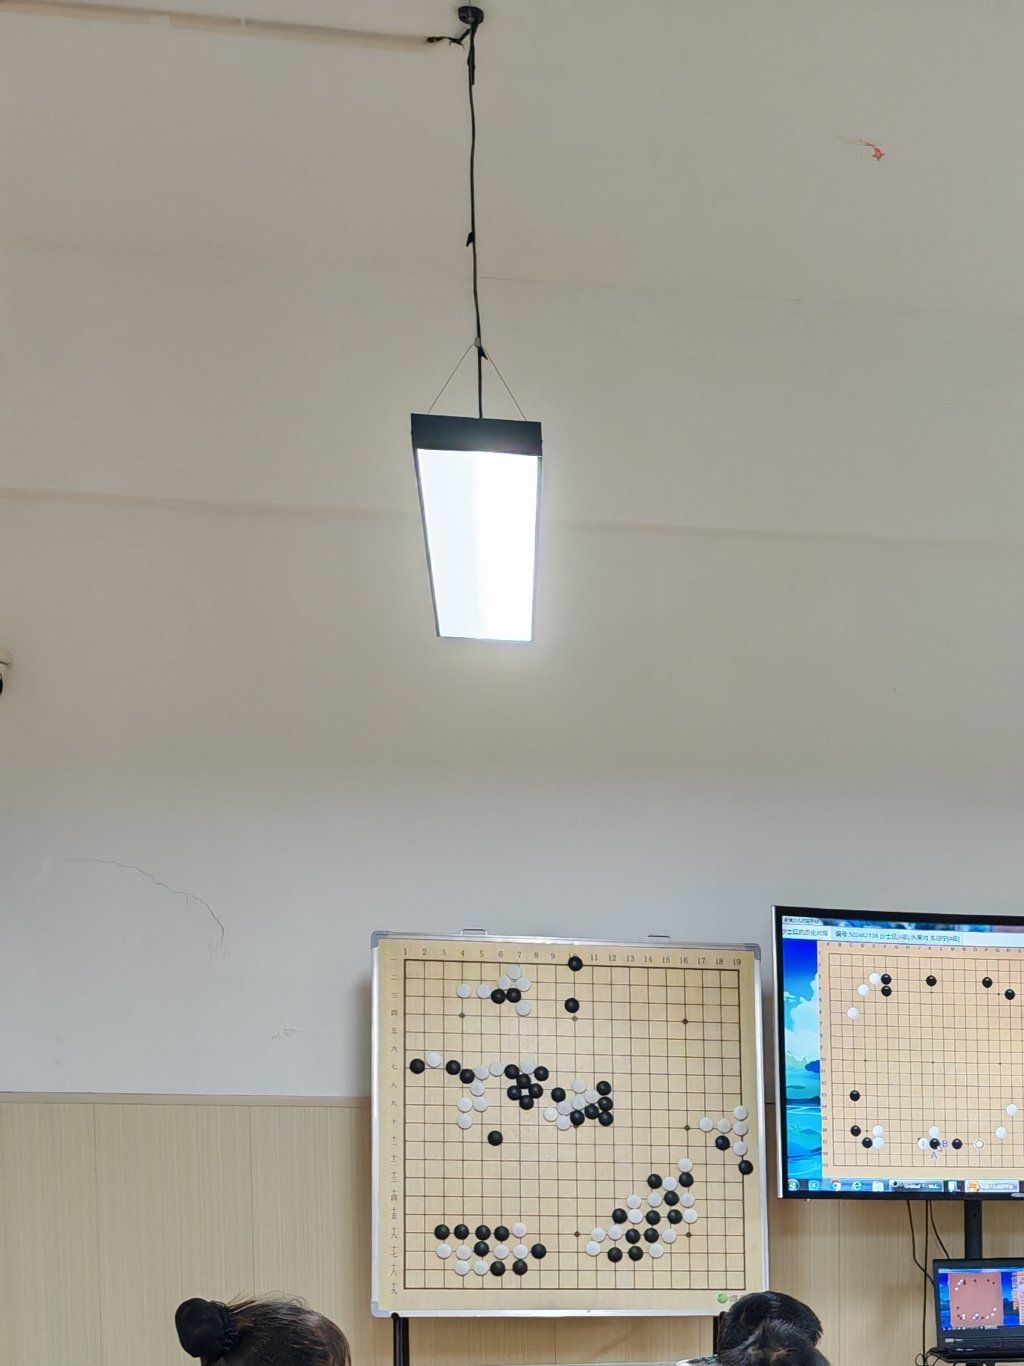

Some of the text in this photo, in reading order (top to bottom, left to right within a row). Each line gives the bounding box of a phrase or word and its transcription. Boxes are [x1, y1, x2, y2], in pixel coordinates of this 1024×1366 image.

[590, 953, 599, 961] 11
[608, 954, 617, 962] 12
[626, 954, 635, 962] 13
[644, 955, 653, 963] 14
[662, 955, 671, 964] 15
[679, 956, 689, 964] 16
[697, 957, 706, 965] 17
[715, 957, 724, 966] 18
[732, 958, 742, 966] 19
